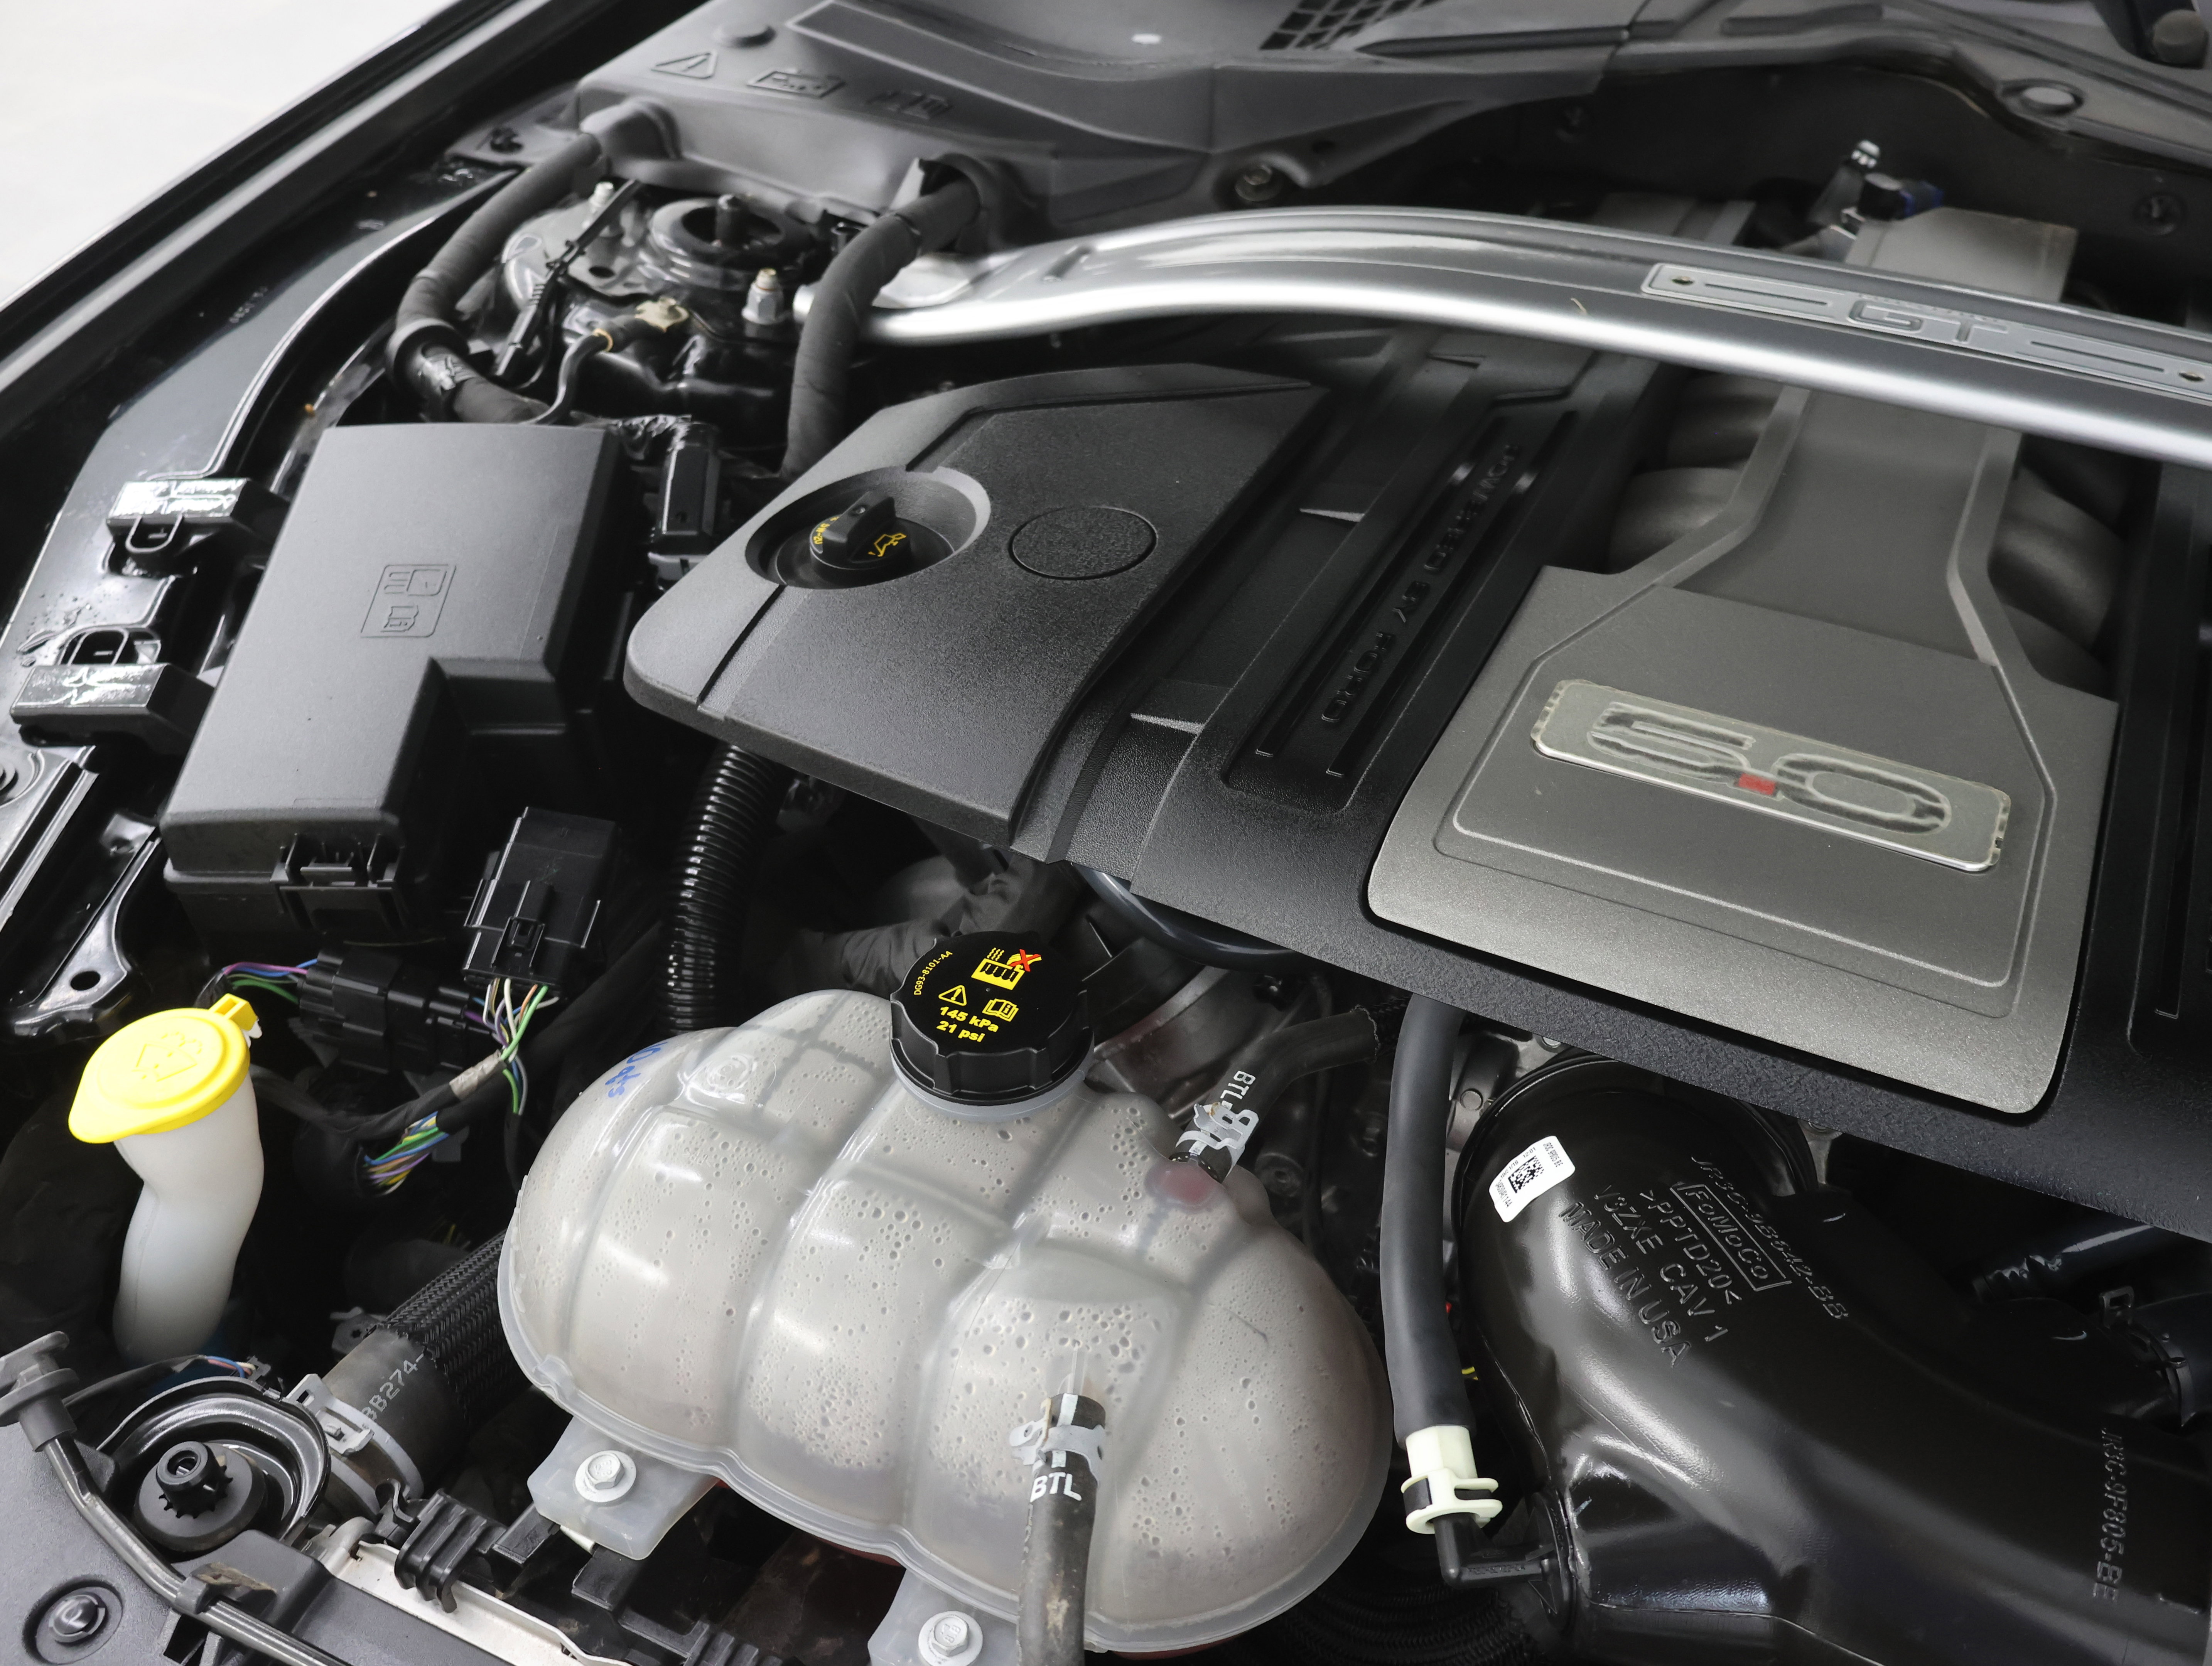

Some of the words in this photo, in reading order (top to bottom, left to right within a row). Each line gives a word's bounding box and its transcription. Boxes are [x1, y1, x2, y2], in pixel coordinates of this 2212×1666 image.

[913, 950, 953, 996] DG93-8101-AA
[936, 1020, 958, 1034] 21
[958, 1029, 985, 1042] psi
[940, 1006, 968, 1022] 145
[969, 1015, 999, 1032] kPa
[1220, 1070, 1256, 1099] BTL
[1684, 1188, 1770, 1280] FoMoCo
[1558, 1201, 1630, 1271] MADE
[1613, 1266, 1653, 1302] IN
[1637, 1299, 1693, 1368] USA
[1659, 1263, 1716, 1317] CAV
[1029, 1472, 1083, 1503] BTL
